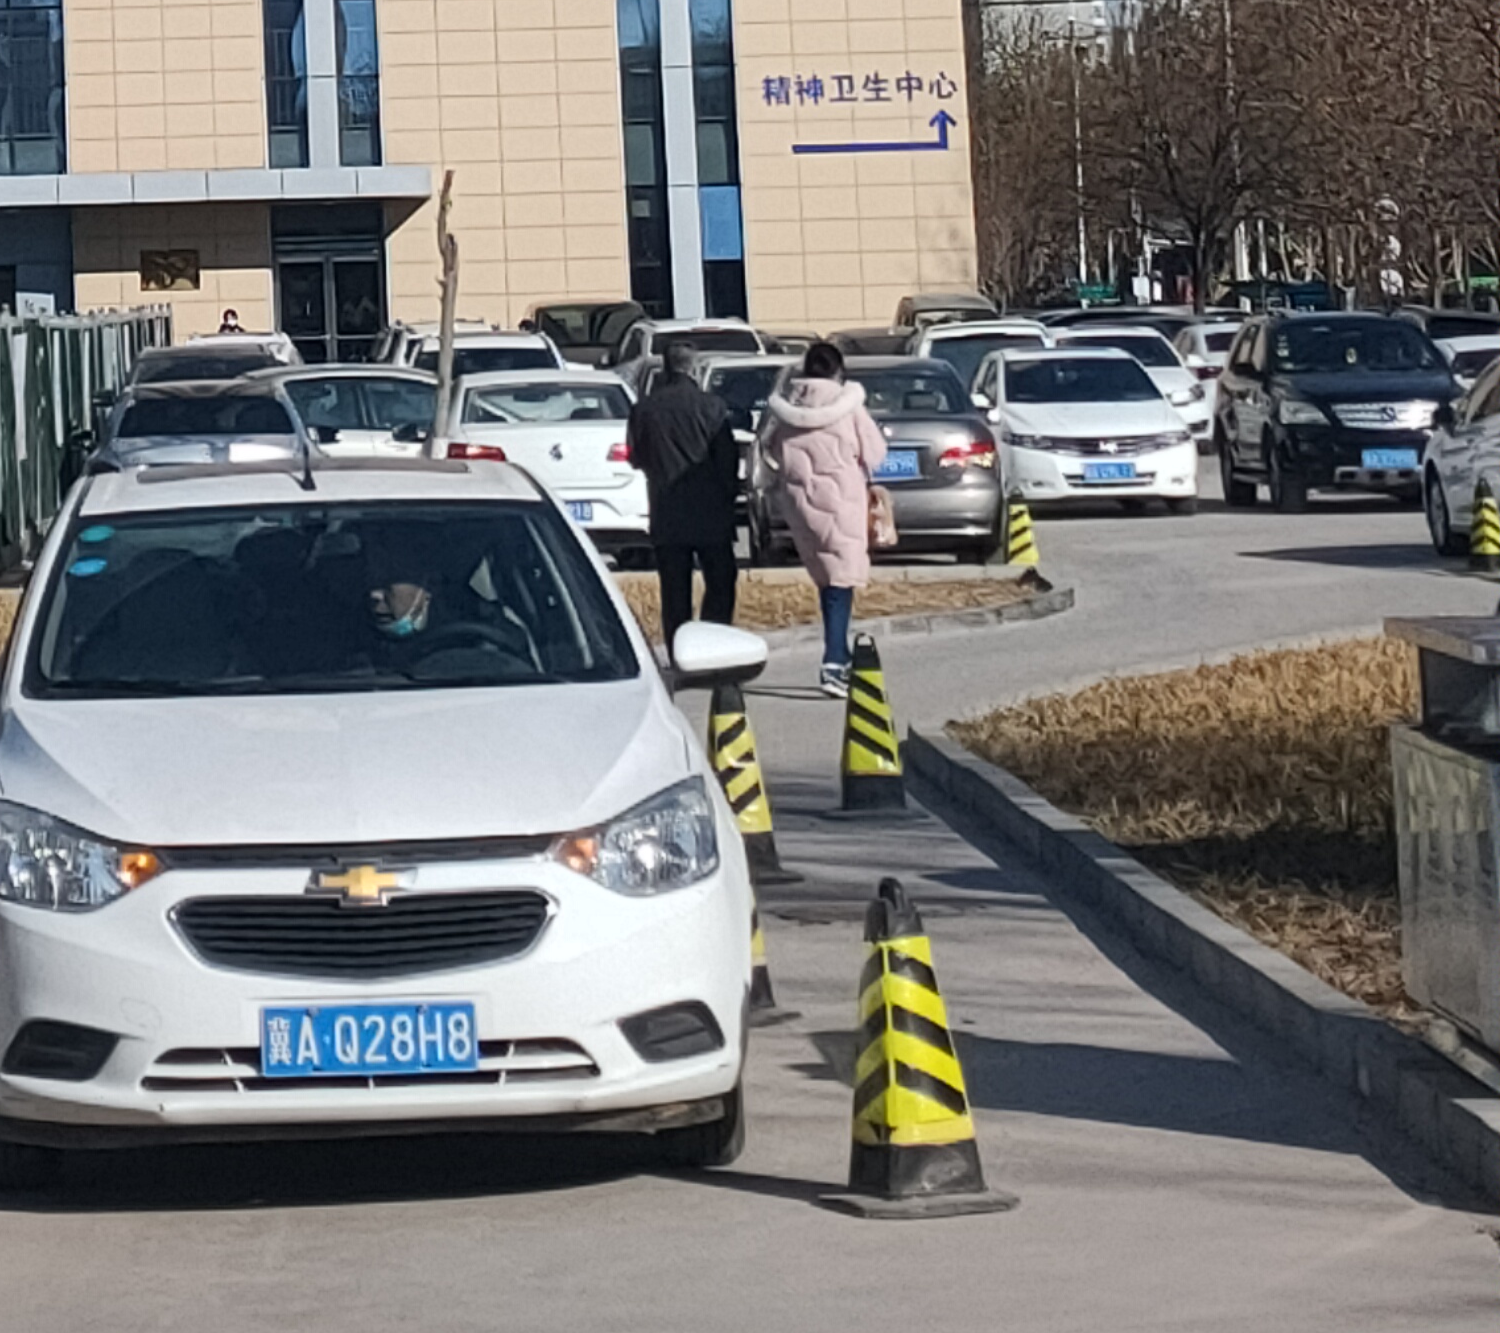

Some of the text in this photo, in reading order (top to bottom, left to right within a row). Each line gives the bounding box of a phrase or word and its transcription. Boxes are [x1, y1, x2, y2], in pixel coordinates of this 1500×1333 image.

[762, 70, 958, 106] 精神卫生中心
